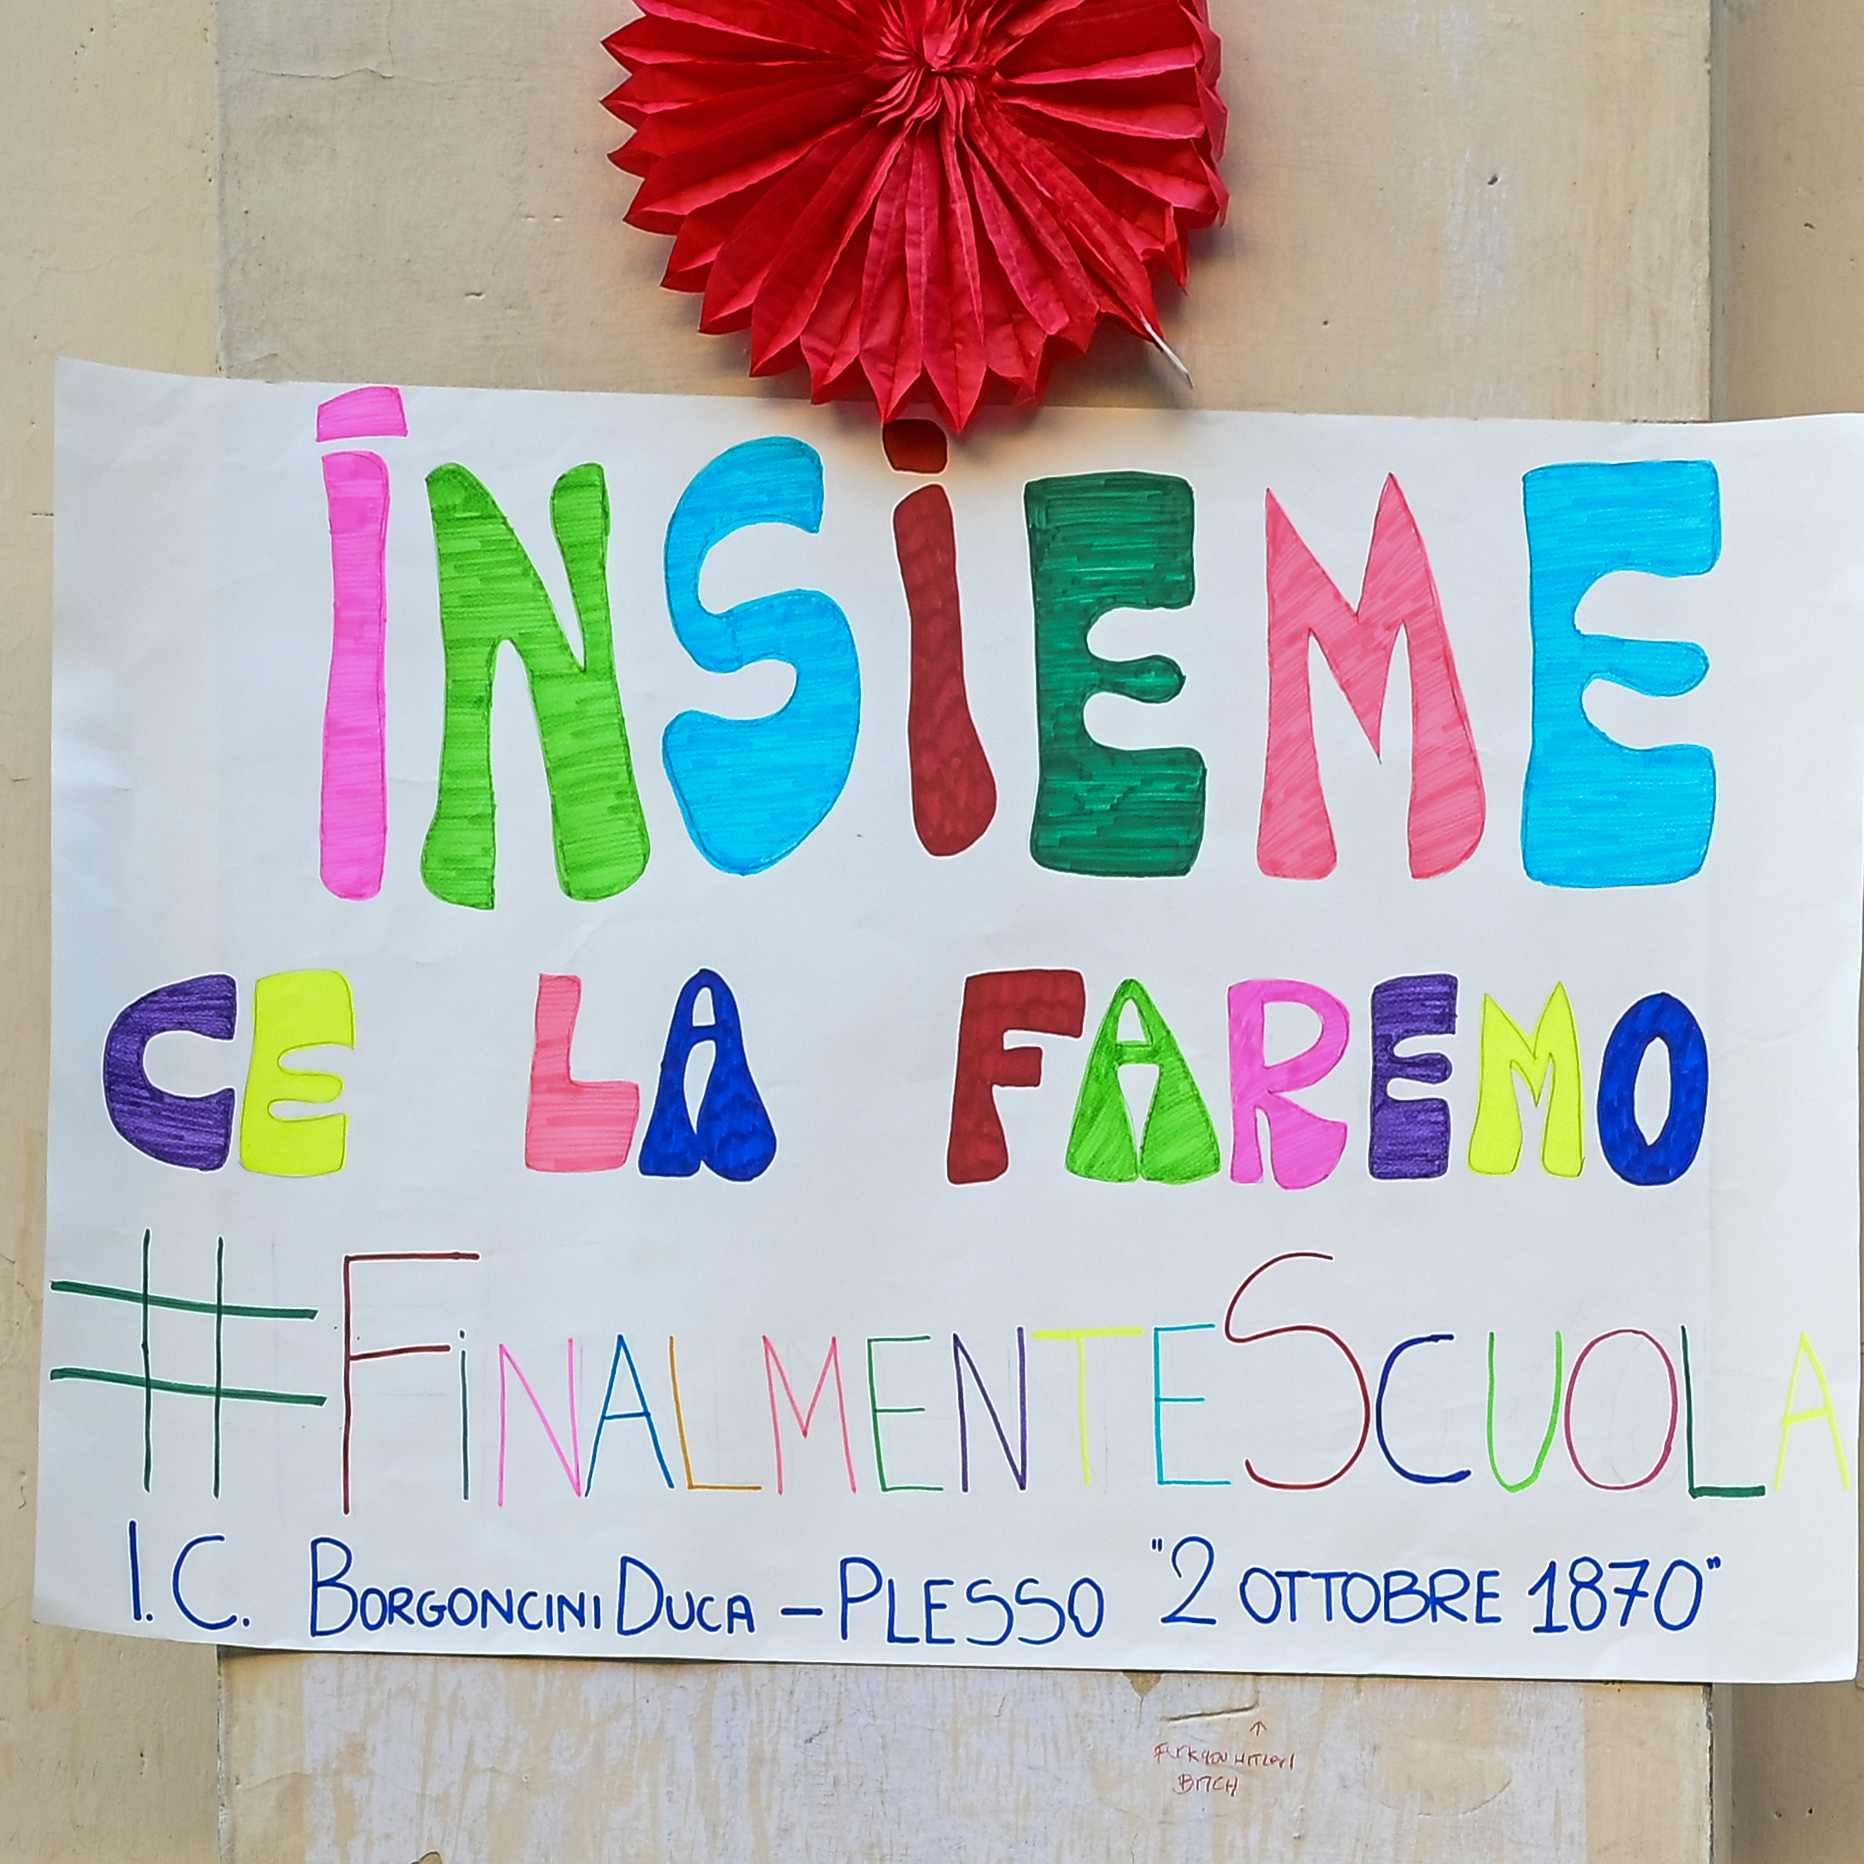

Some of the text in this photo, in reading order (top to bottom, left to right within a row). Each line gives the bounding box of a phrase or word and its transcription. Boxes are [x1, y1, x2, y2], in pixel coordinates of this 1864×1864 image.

[102, 969, 1710, 1191] CE LA FAREMO
[1239, 1567, 1503, 1625] OTTOBRE
